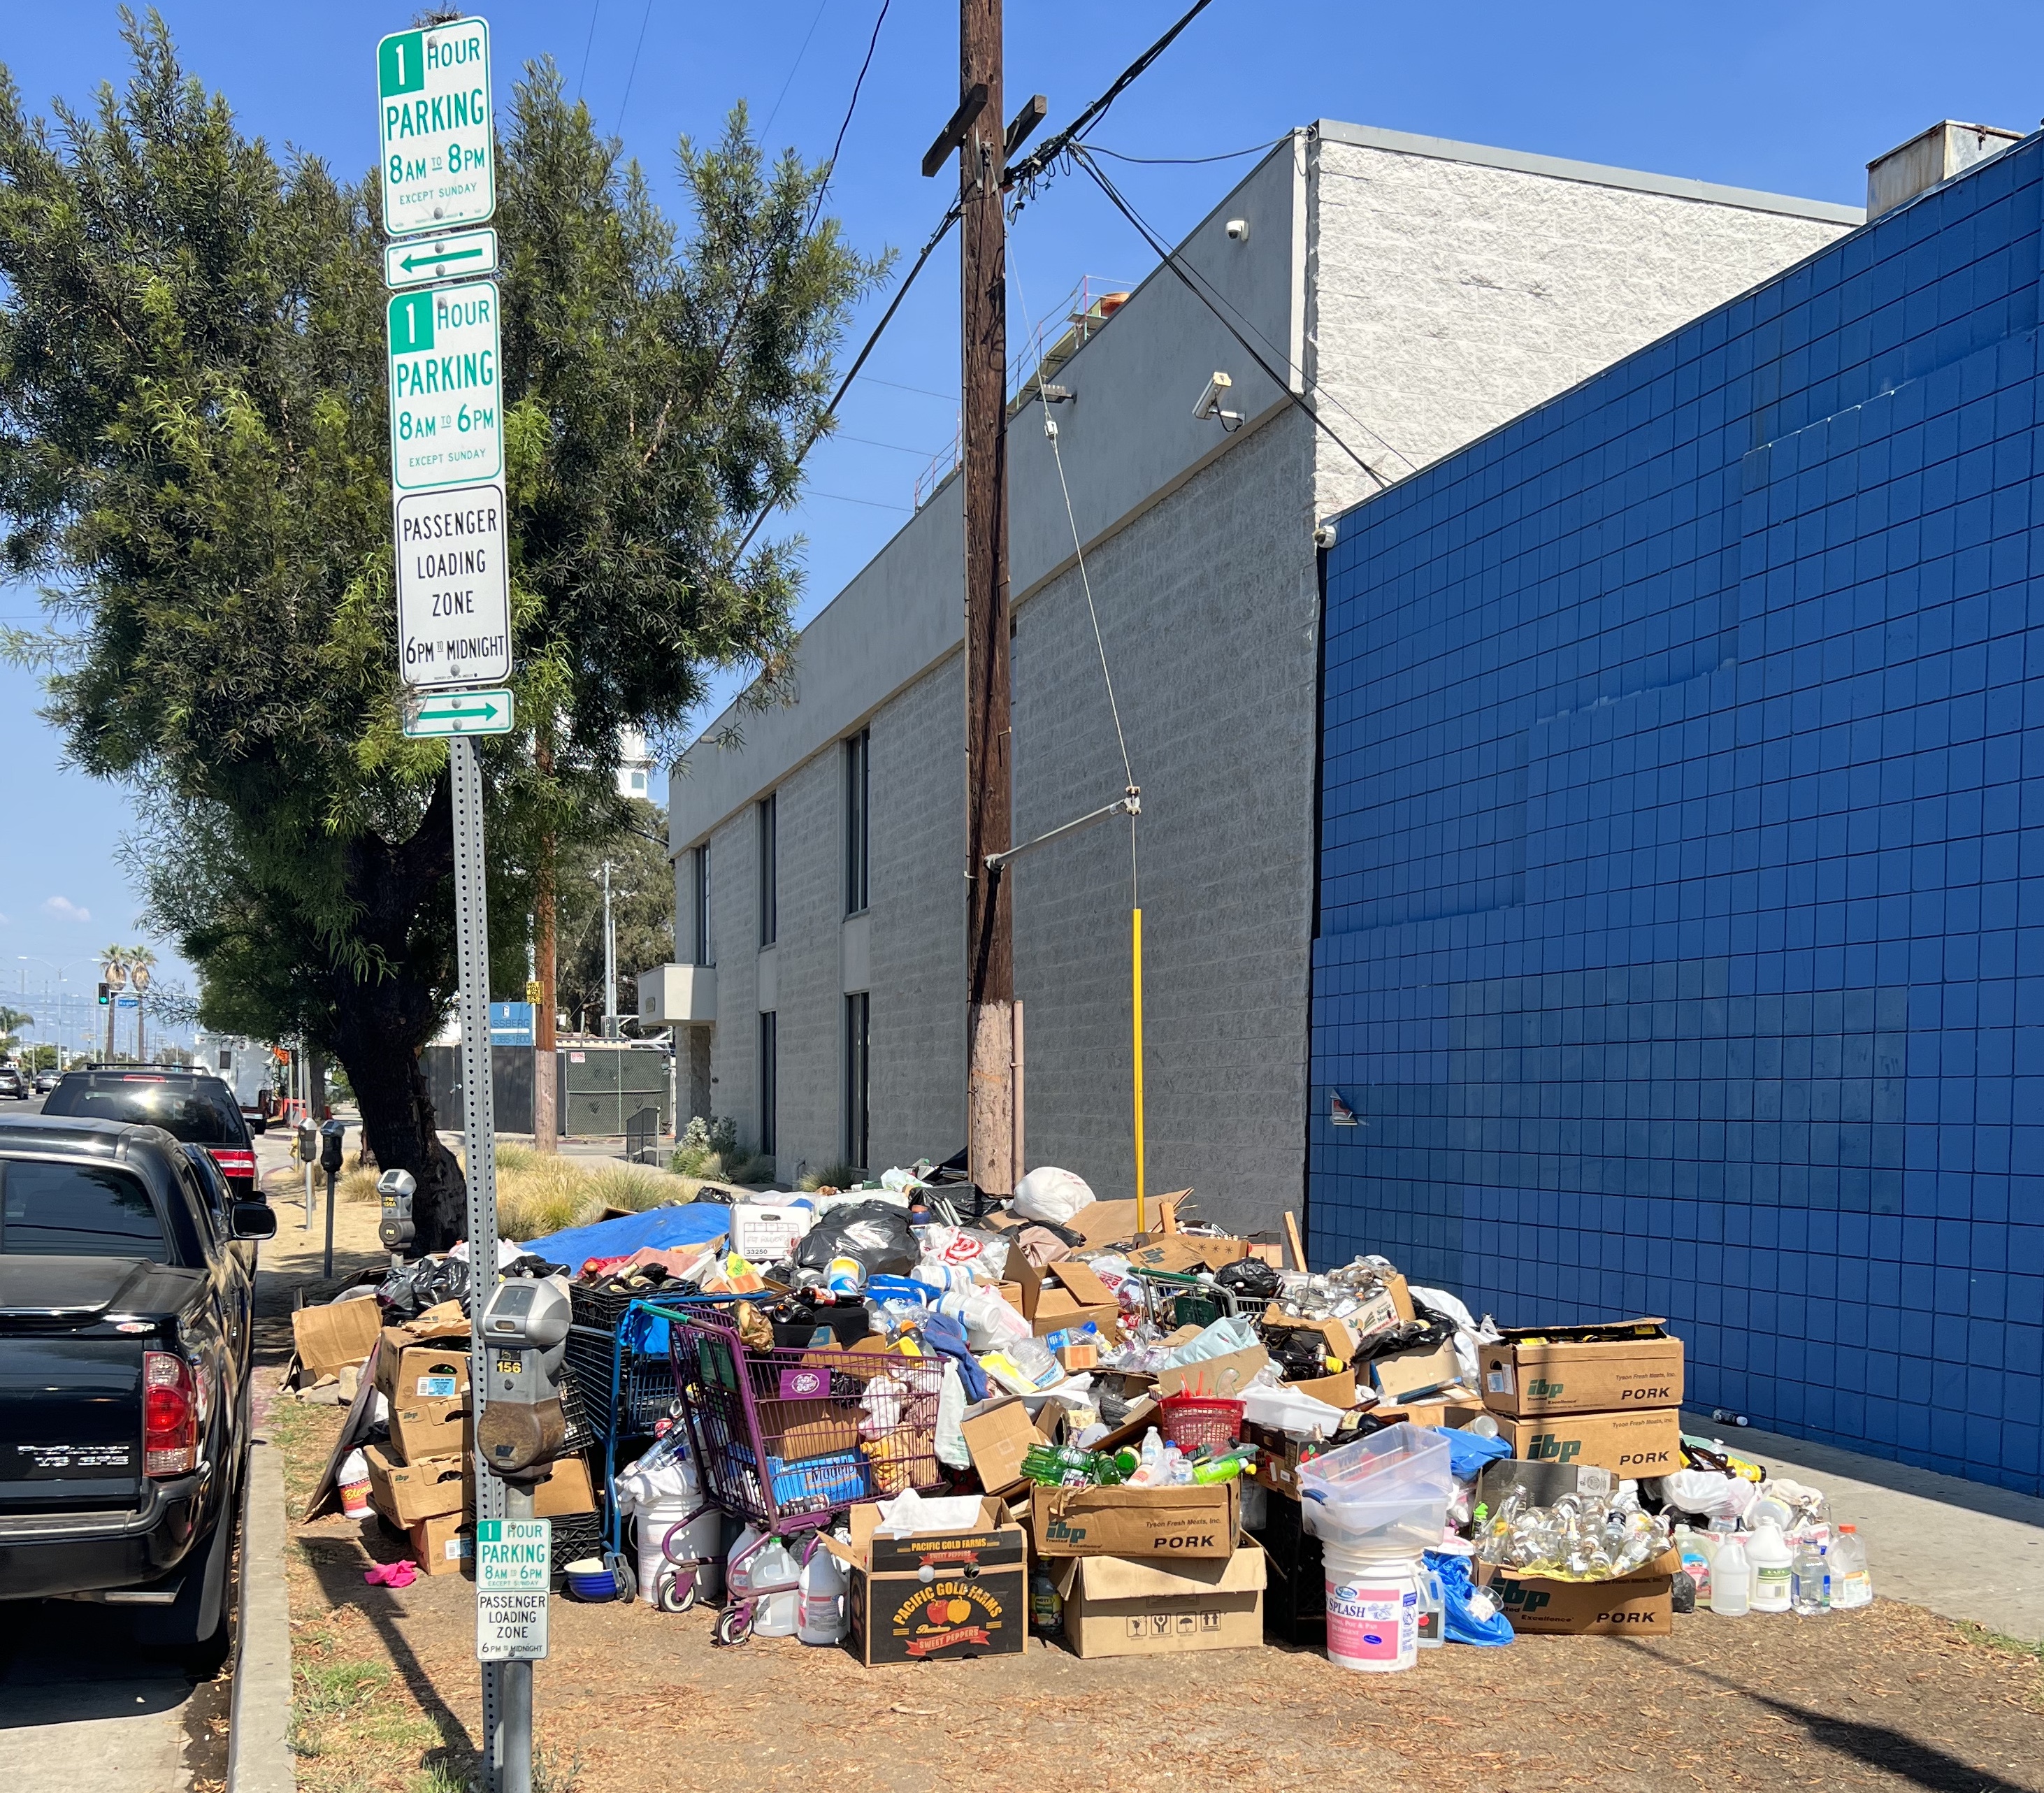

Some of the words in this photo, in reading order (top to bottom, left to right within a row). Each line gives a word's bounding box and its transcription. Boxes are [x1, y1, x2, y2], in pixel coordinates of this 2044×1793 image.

[396, 43, 405, 86] 1
[428, 37, 480, 71] HOUR
[387, 88, 484, 141] PARKING
[389, 154, 426, 185] 8AM
[432, 157, 442, 167] TO
[448, 143, 485, 173] 8PM
[400, 190, 434, 205] EXCEPT
[438, 182, 477, 198] SUNDAY
[406, 302, 415, 344] 1
[437, 299, 490, 330] HOUR
[396, 350, 494, 398] PARKING
[399, 411, 436, 440] 8AM
[441, 415, 452, 425] TO
[457, 403, 494, 433] 6PM
[409, 454, 444, 468] EXCEPT
[448, 448, 486, 462] SUNDAY
[403, 507, 497, 542] PASSENGER
[417, 549, 487, 579] LOADING
[432, 590, 475, 617] ZONE
[405, 636, 435, 664] 6PM
[437, 640, 444, 651] TO
[447, 635, 505, 661] MIDNIGHT
[496, 1361, 522, 1374] 156
[1527, 1378, 1564, 1398] ibp
[1621, 1387, 1671, 1400] PORK
[1527, 1434, 1582, 1463] ibp
[1620, 1450, 1670, 1466] PORK
[811, 1459, 855, 1483] Modelo
[487, 1522, 492, 1540] 1
[508, 1525, 542, 1539] HOUR
[1046, 1521, 1086, 1543] ibp
[1153, 1535, 1216, 1548] PORK
[482, 1543, 545, 1564] PARKING
[911, 1542, 941, 1552] PACIFIC
[942, 1540, 961, 1550] GOLD
[962, 1538, 987, 1548] FARMS
[948, 1550, 971, 1558] PEPPERS
[484, 1565, 508, 1580] 8AM
[520, 1565, 542, 1579] 6PM
[480, 1595, 546, 1608] PASSENGER
[892, 1586, 935, 1626] PACIFIC
[936, 1581, 969, 1597] GOLD
[967, 1585, 1003, 1618] FARMS
[1329, 1598, 1366, 1618] SPLASH
[489, 1611, 537, 1624] LOADING
[1597, 1611, 1656, 1623] PORK
[496, 1626, 529, 1639] ZONE
[919, 1637, 944, 1649] SWEET
[946, 1628, 979, 1643] PEPPERS
